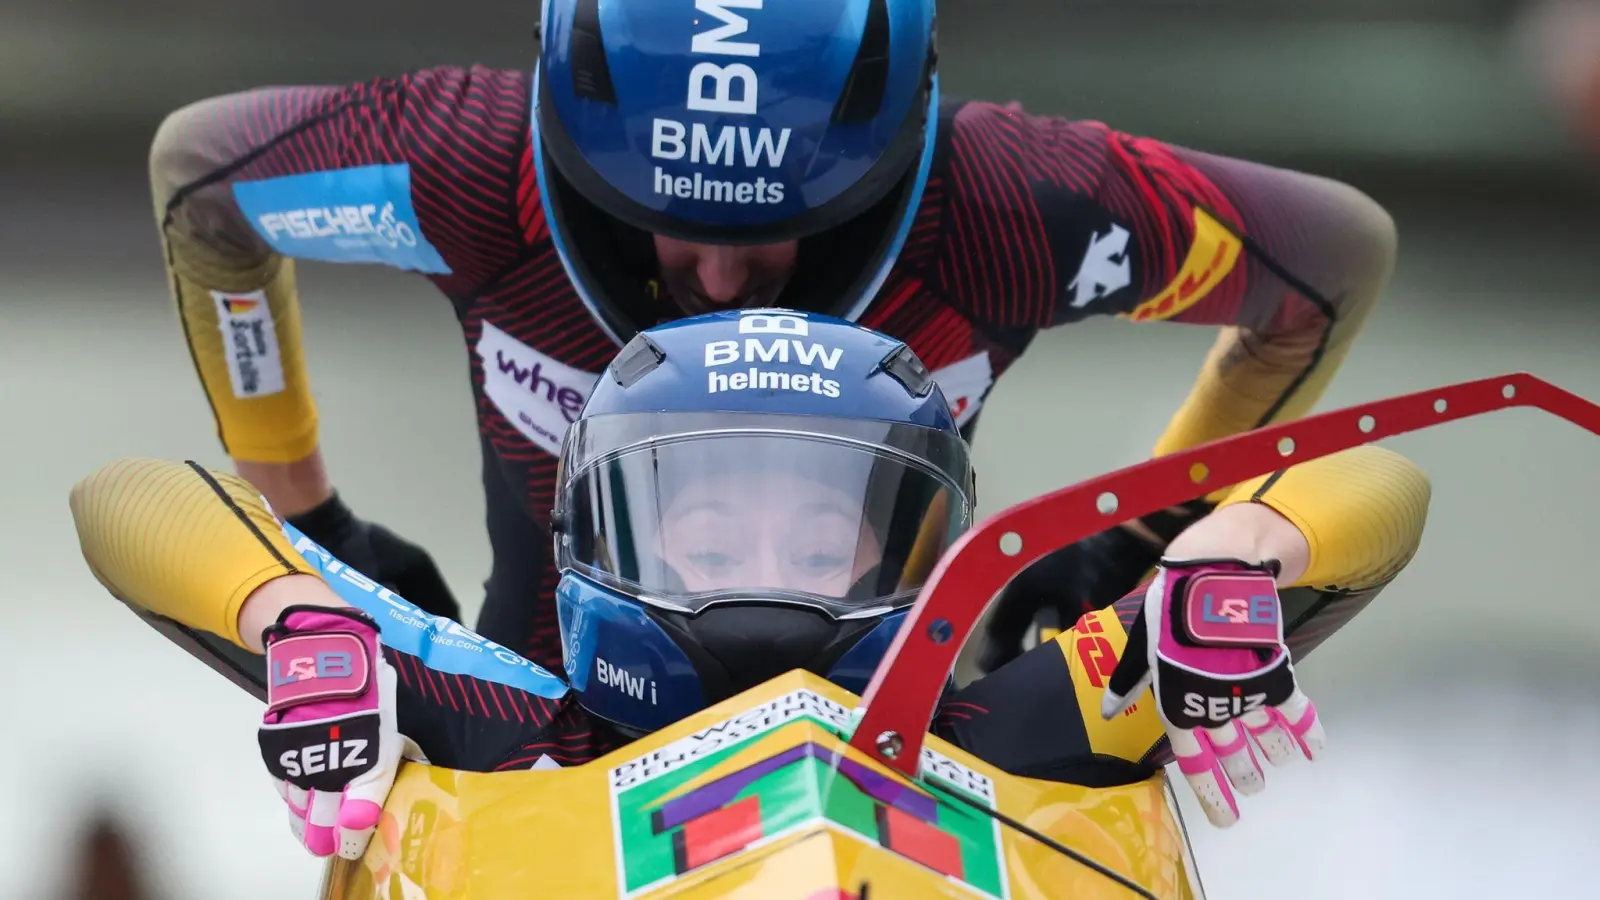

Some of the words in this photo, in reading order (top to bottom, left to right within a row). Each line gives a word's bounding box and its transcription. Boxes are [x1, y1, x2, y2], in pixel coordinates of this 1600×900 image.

[687, 0, 764, 115] BM
[652, 118, 792, 168] BMW
[654, 167, 785, 205] helmets
[705, 338, 844, 371] BMW
[497, 349, 584, 424] whe
[708, 367, 841, 398] helmets
[389, 608, 483, 652] fischer-bike.com
[597, 657, 644, 700] BMW
[651, 680, 657, 705] i
